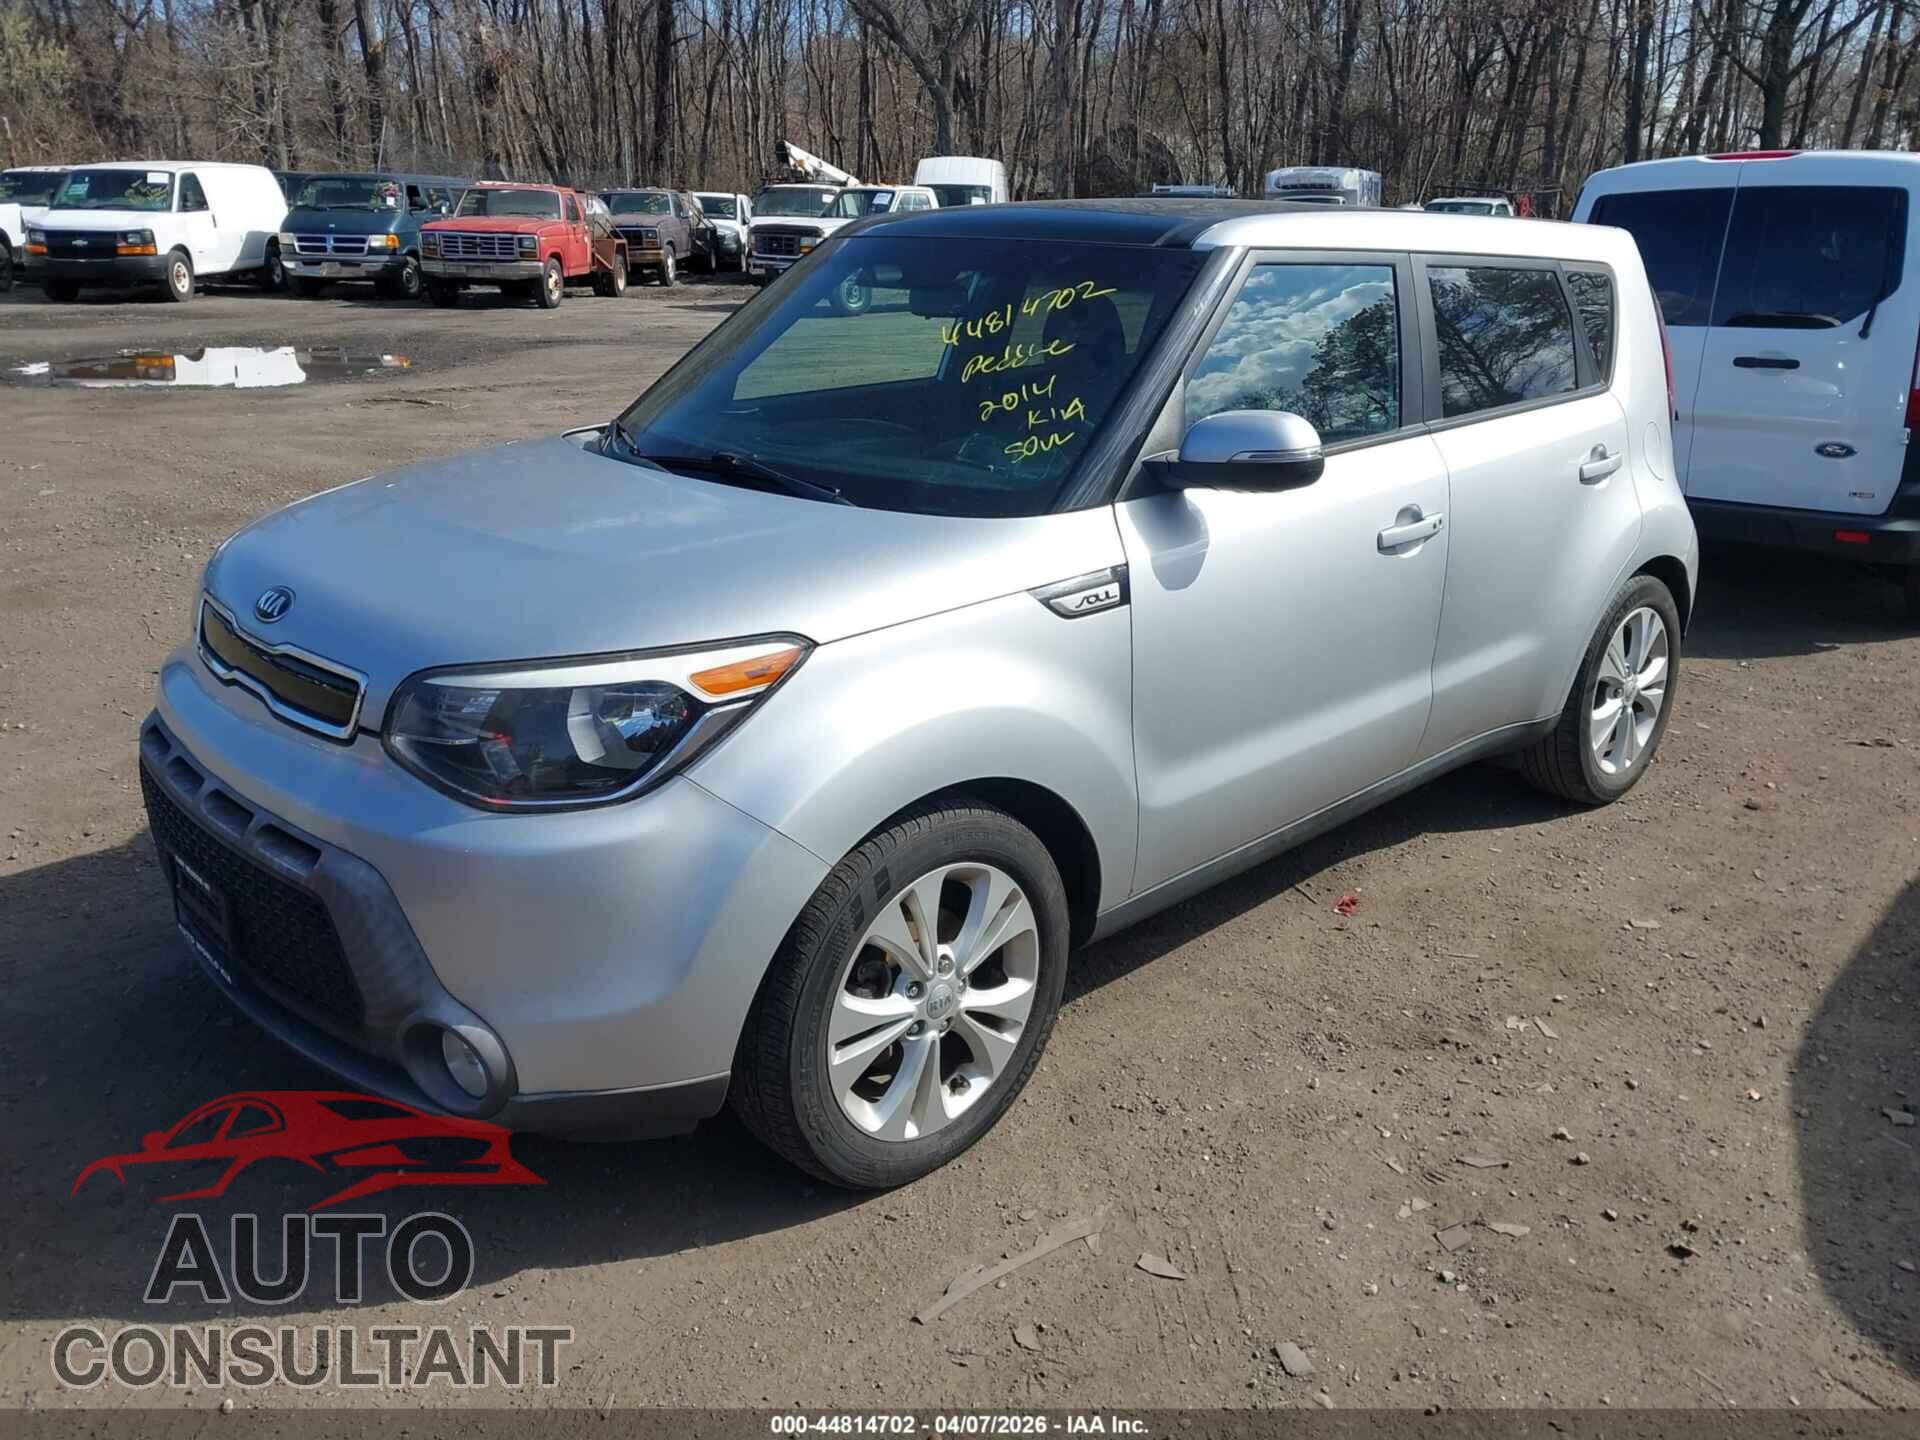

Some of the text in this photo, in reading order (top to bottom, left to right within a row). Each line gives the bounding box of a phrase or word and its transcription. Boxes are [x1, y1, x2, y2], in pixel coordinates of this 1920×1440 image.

[978, 374, 1057, 422] 2014
[1027, 396, 1086, 431] KIA
[256, 590, 287, 617] KIA
